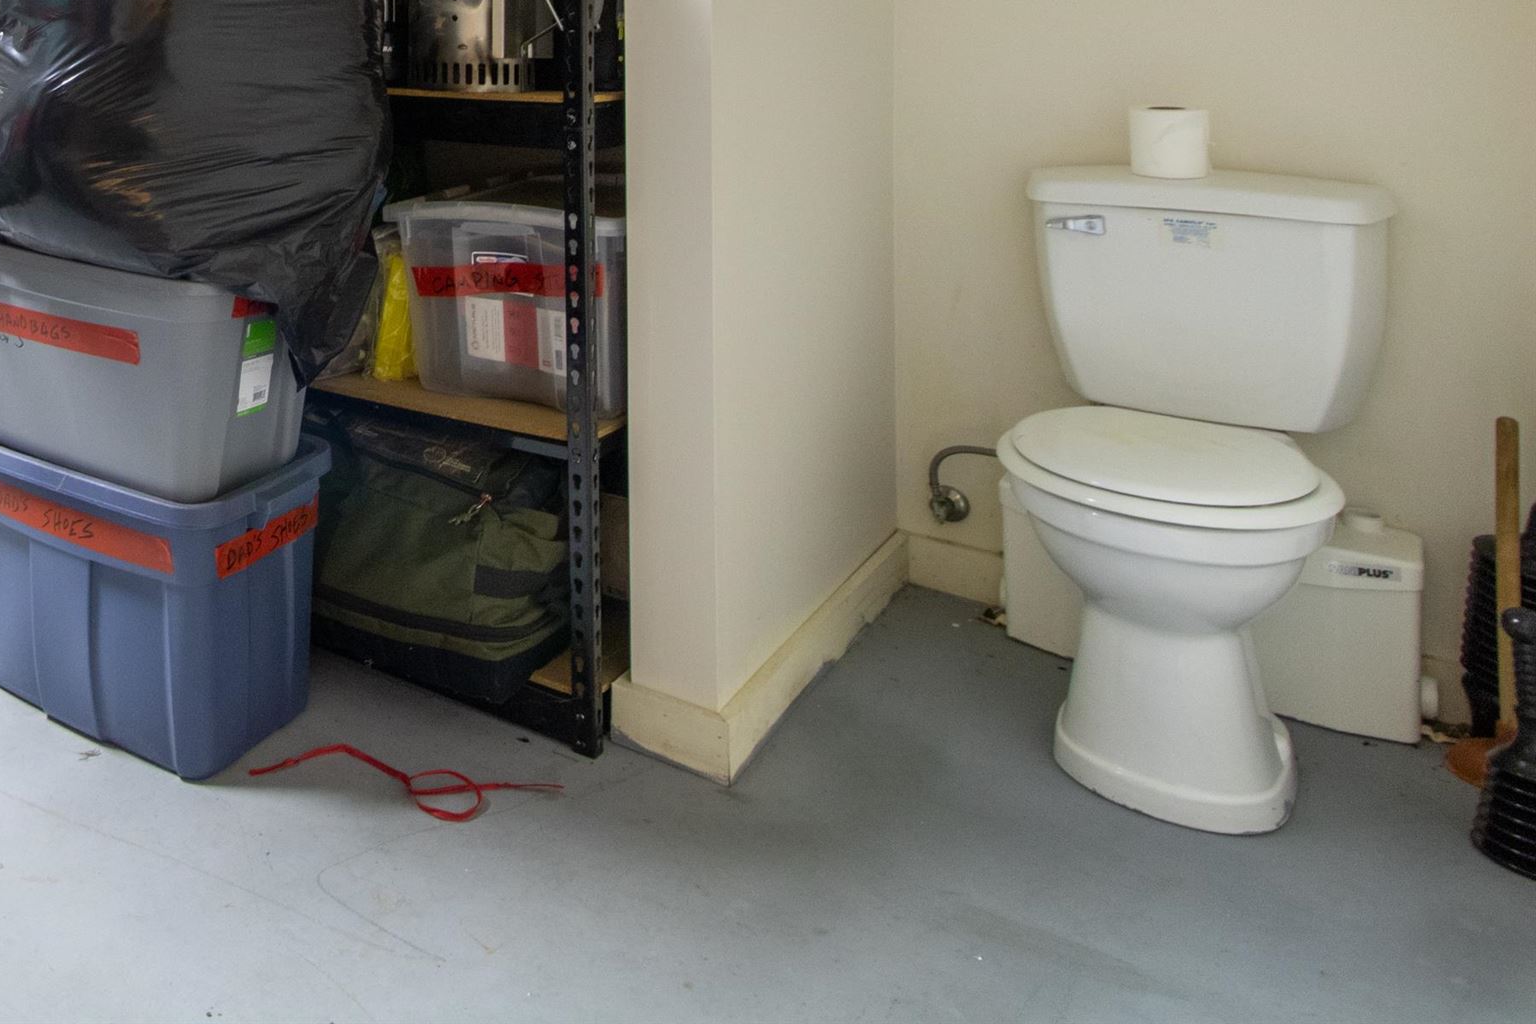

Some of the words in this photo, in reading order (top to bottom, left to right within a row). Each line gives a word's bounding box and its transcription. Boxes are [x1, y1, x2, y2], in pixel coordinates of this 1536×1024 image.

[41, 508, 94, 538] SHOES
[226, 531, 263, 570] DAD'S
[270, 513, 309, 550] SHOES
